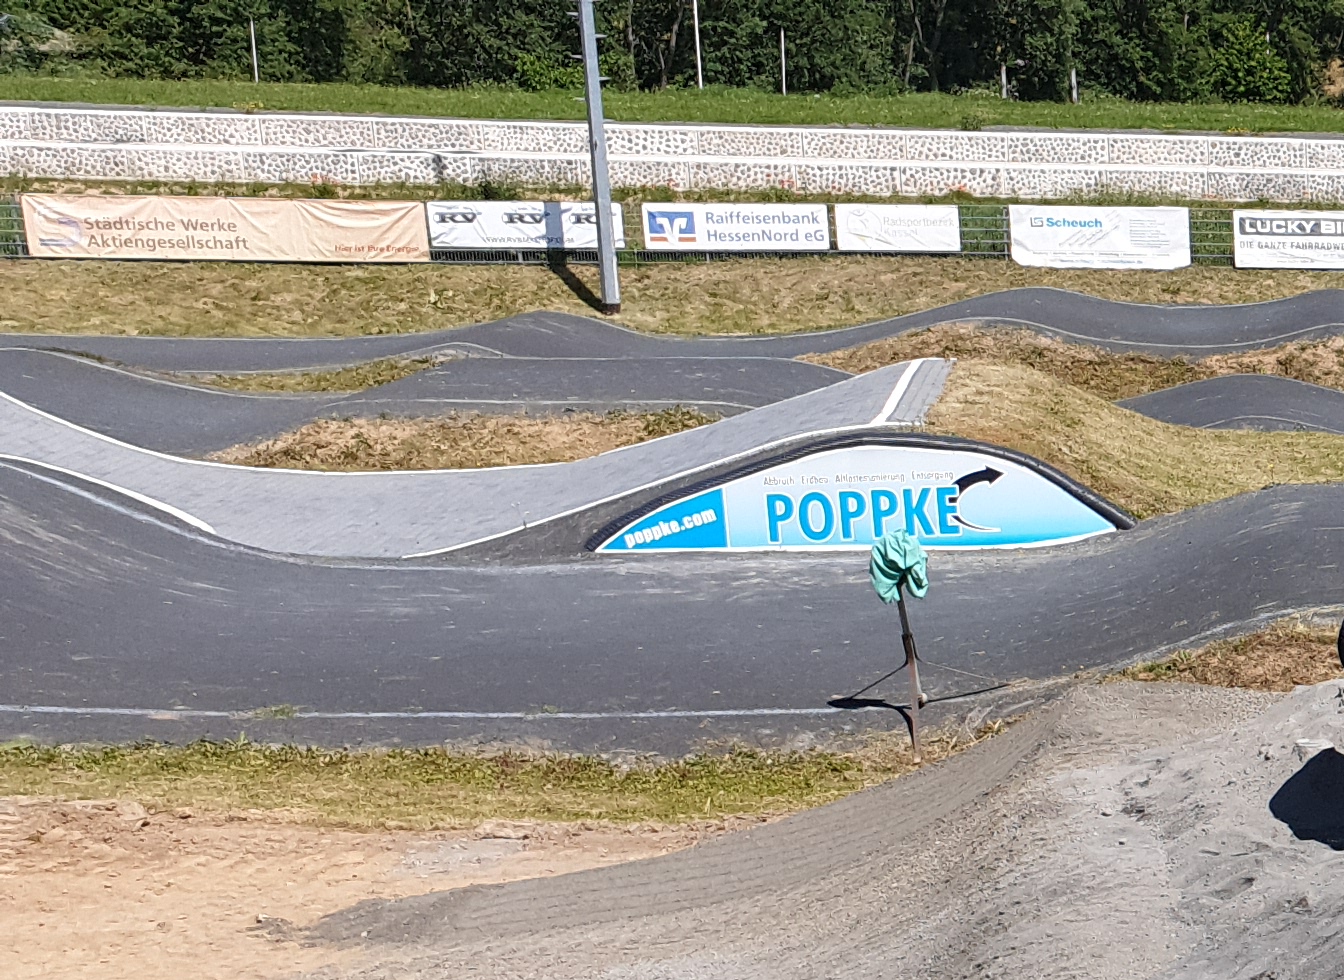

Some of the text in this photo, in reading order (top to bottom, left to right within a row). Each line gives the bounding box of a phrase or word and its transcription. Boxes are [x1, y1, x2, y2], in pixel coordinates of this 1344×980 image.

[84, 216, 238, 233] Städtische Werke
[705, 211, 820, 225] Raiffeisenbank
[1046, 217, 1103, 228] Scheuch
[1245, 218, 1316, 234] LUCKY
[87, 234, 250, 251] Aktiengesellschaft
[707, 229, 825, 243] HessenNord eG
[1239, 240, 1255, 249] DIE
[1257, 241, 1287, 250] GANZE
[765, 486, 962, 543] POPPKE
[624, 509, 718, 549] poppke.com
